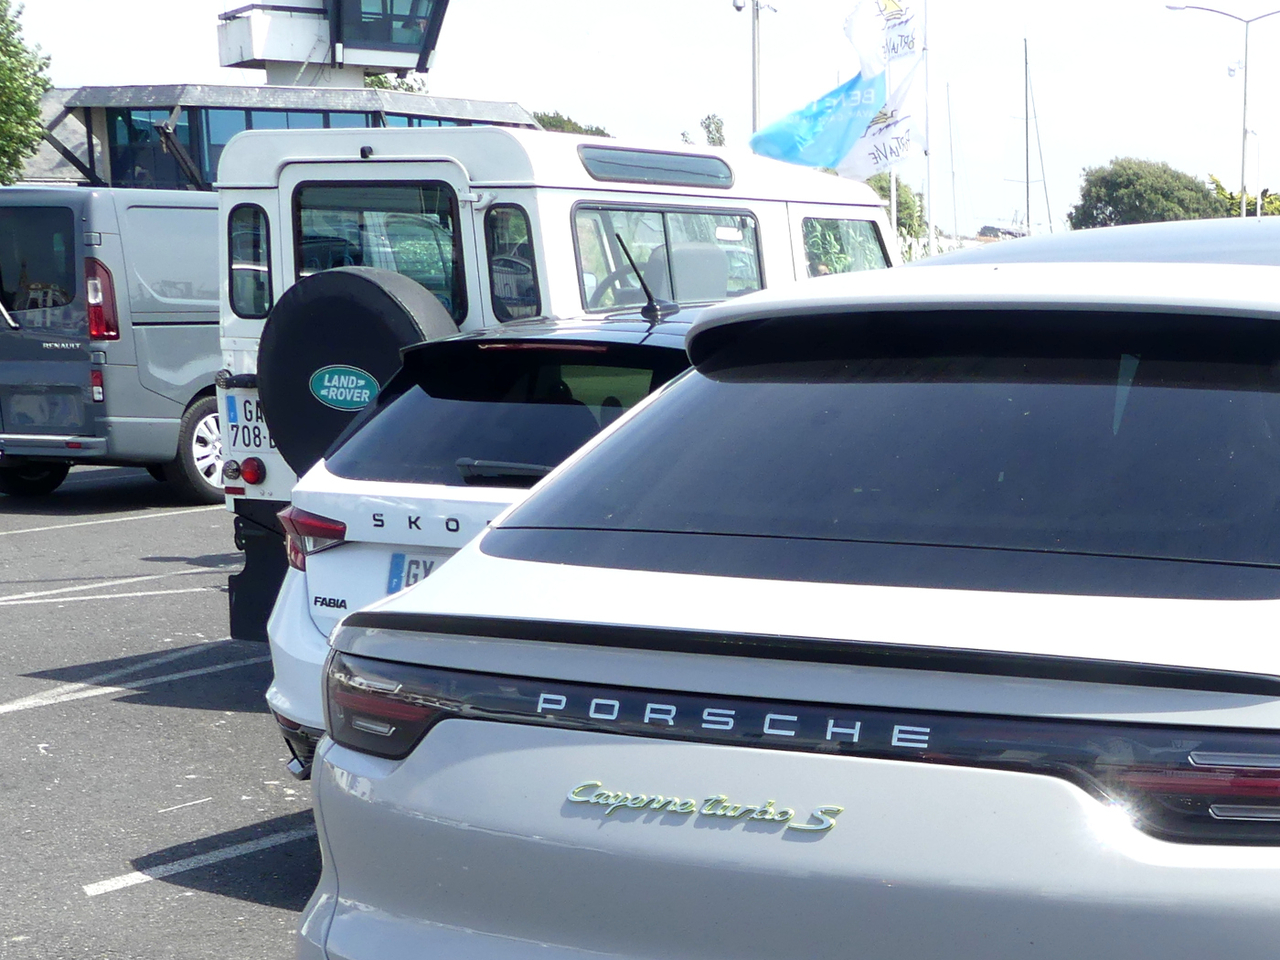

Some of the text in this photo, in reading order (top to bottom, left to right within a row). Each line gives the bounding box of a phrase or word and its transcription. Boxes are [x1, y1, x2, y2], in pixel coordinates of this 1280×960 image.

[324, 374, 357, 388] LAND
[328, 387, 370, 402] ROVER
[373, 513, 492, 533] SKO
[313, 596, 347, 610] FABIA
[537, 693, 930, 748] PORSCHE
[567, 781, 845, 833] Cayenne turbo S
